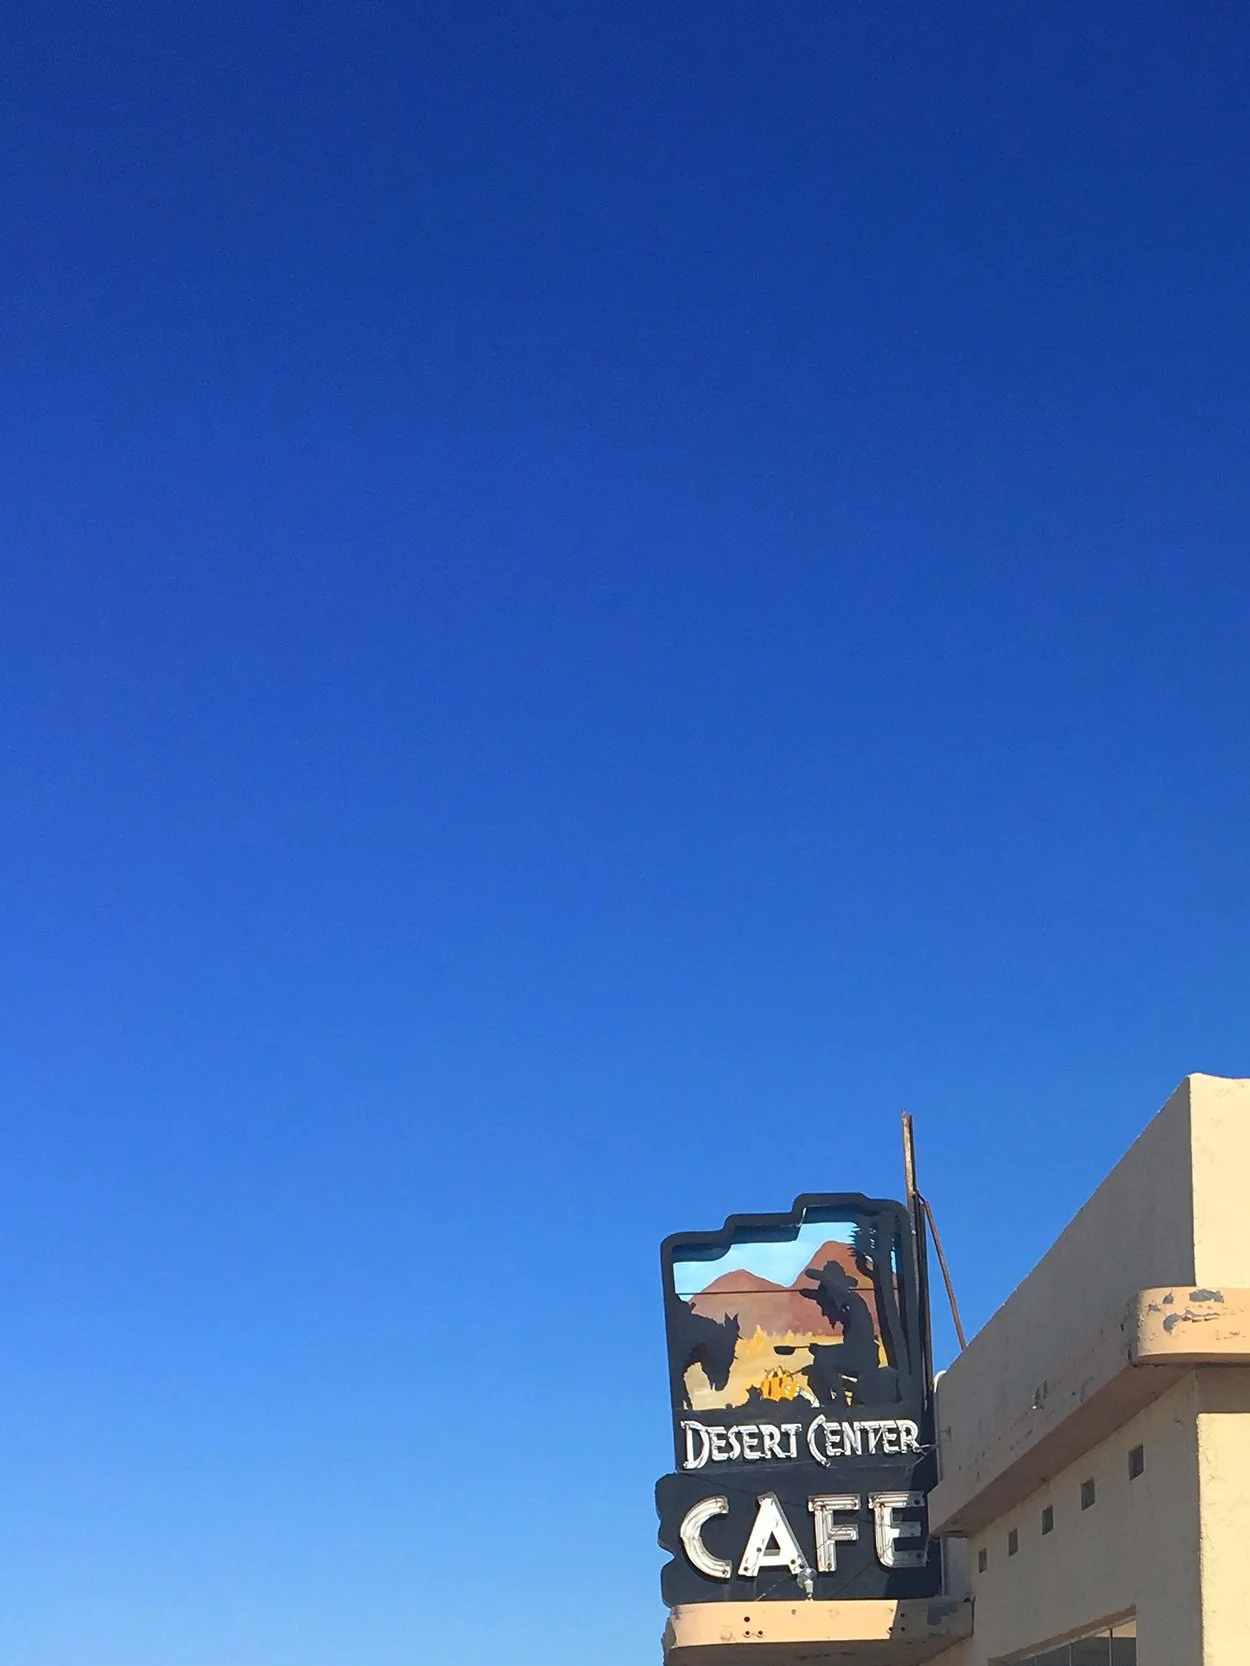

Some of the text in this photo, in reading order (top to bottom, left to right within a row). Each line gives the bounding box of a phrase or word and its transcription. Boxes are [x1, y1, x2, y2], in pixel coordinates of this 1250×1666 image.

[680, 1413, 921, 1470] DESERT CENTER
[679, 1490, 927, 1579] CAFE
